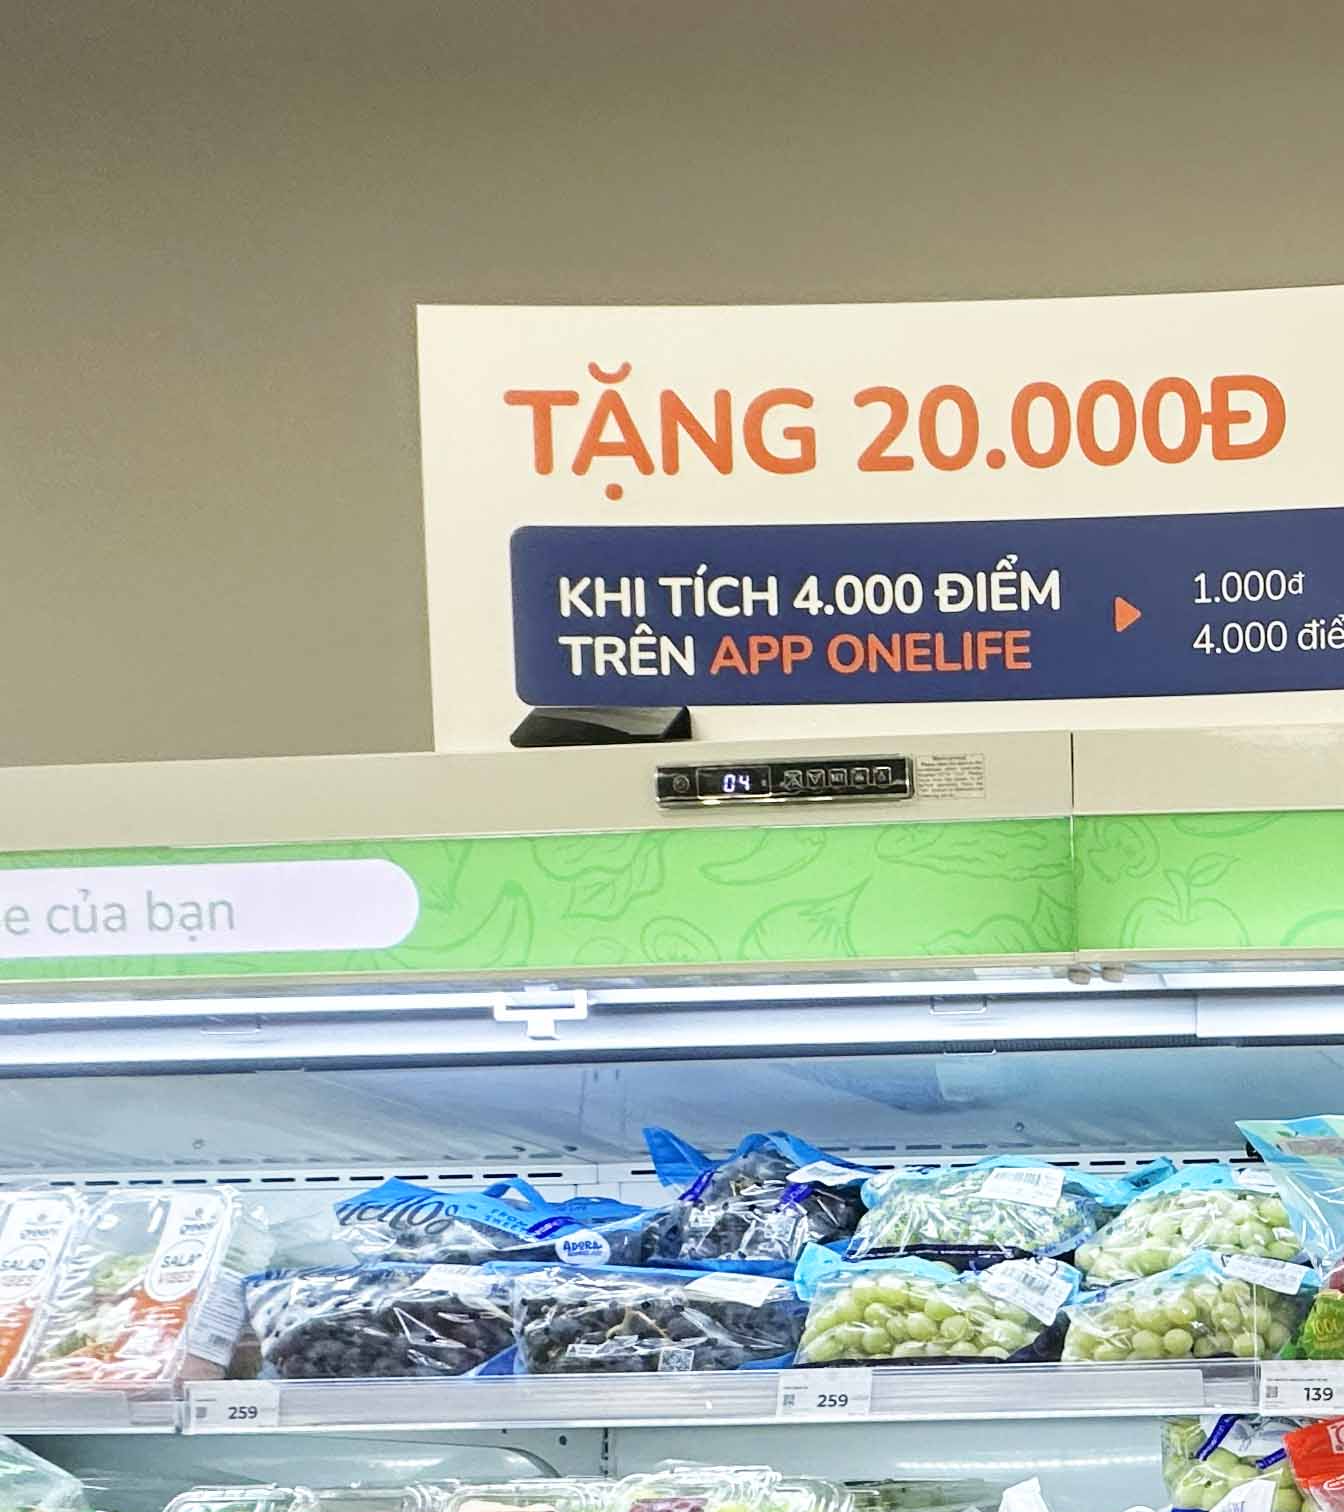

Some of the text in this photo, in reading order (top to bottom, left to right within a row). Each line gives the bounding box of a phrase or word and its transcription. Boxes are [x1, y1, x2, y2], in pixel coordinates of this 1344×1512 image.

[504, 361, 1287, 500] TẶNG 20.000Đ
[559, 554, 1061, 618] KHI TÍCH 4.000 ĐIỂM
[559, 624, 1031, 676] TRÊN APP ONELIFE
[1193, 620, 1288, 655] 4.000
[723, 773, 750, 792] 04
[46, 888, 236, 943] của bạn
[816, 1393, 849, 1408] 259
[1303, 1387, 1334, 1401] 139
[228, 1405, 258, 1420] 259
